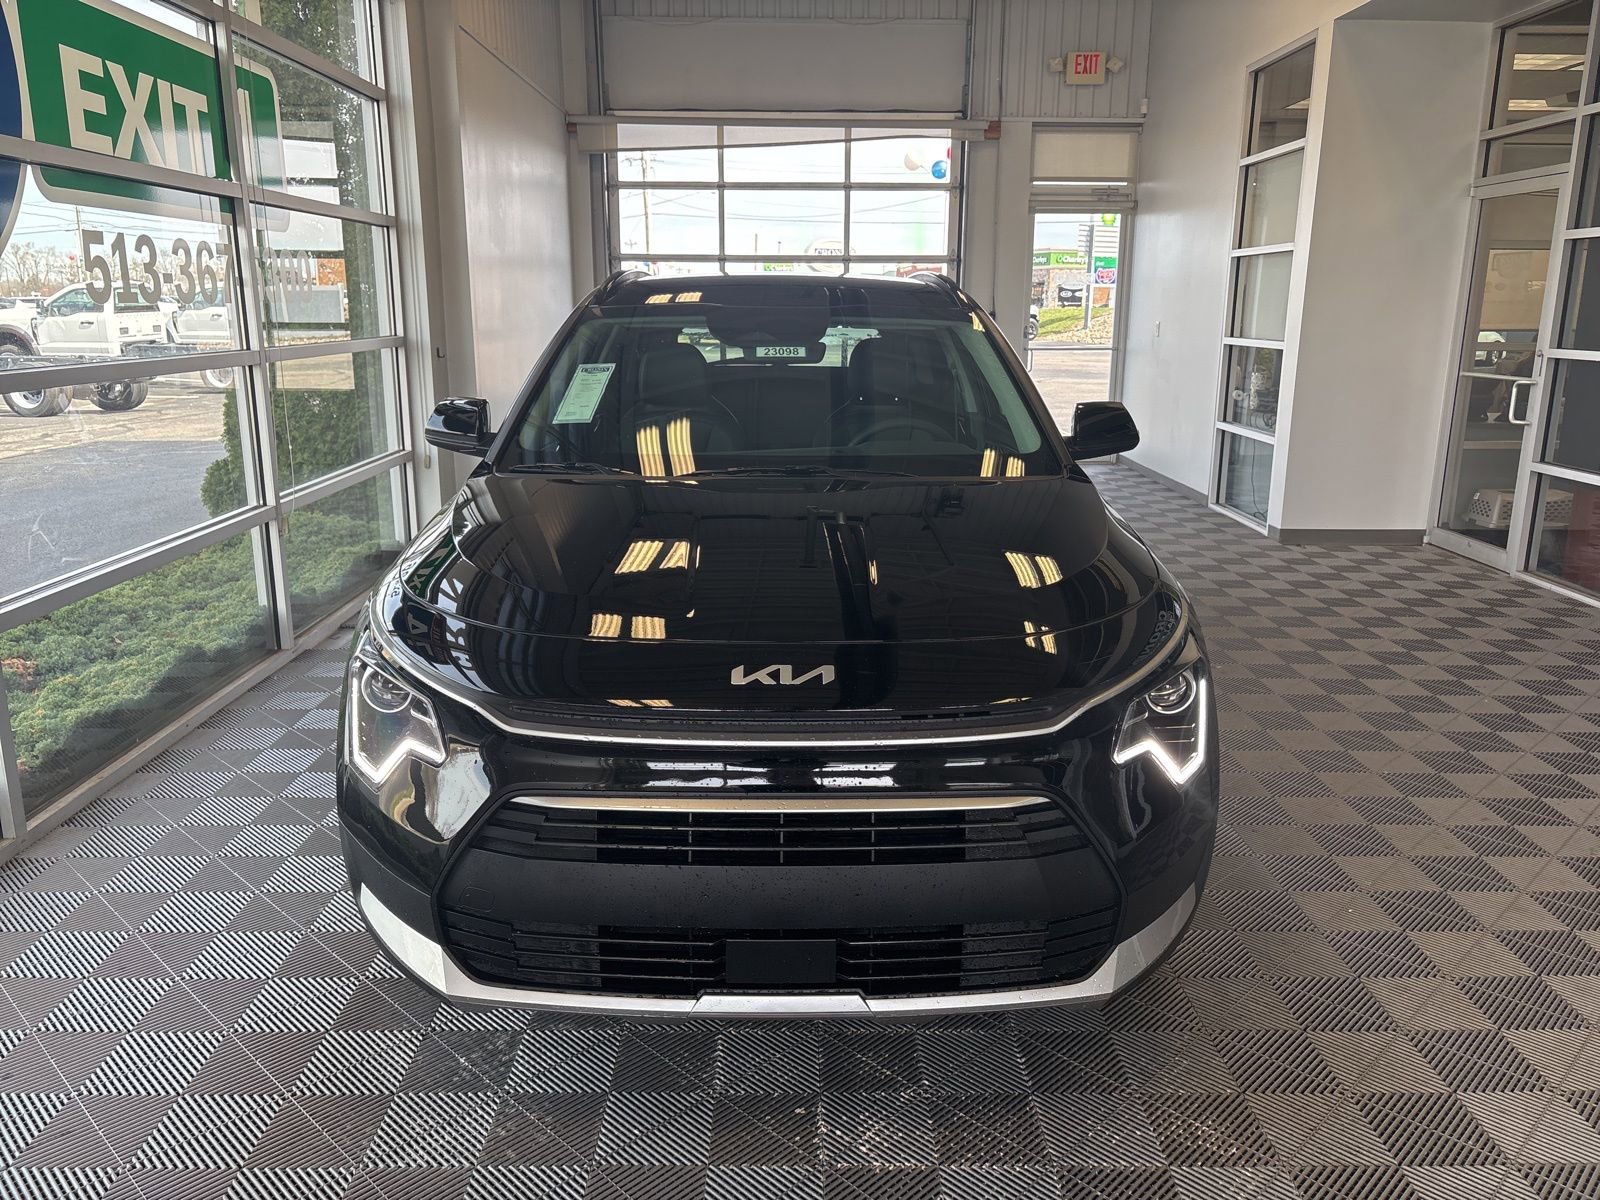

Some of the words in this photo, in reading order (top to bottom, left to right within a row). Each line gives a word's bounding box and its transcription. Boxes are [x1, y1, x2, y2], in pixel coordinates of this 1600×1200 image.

[1074, 54, 1100, 75] EXIT
[58, 43, 216, 179] EXIT
[764, 347, 800, 356] 23098
[731, 664, 835, 685] KIA
